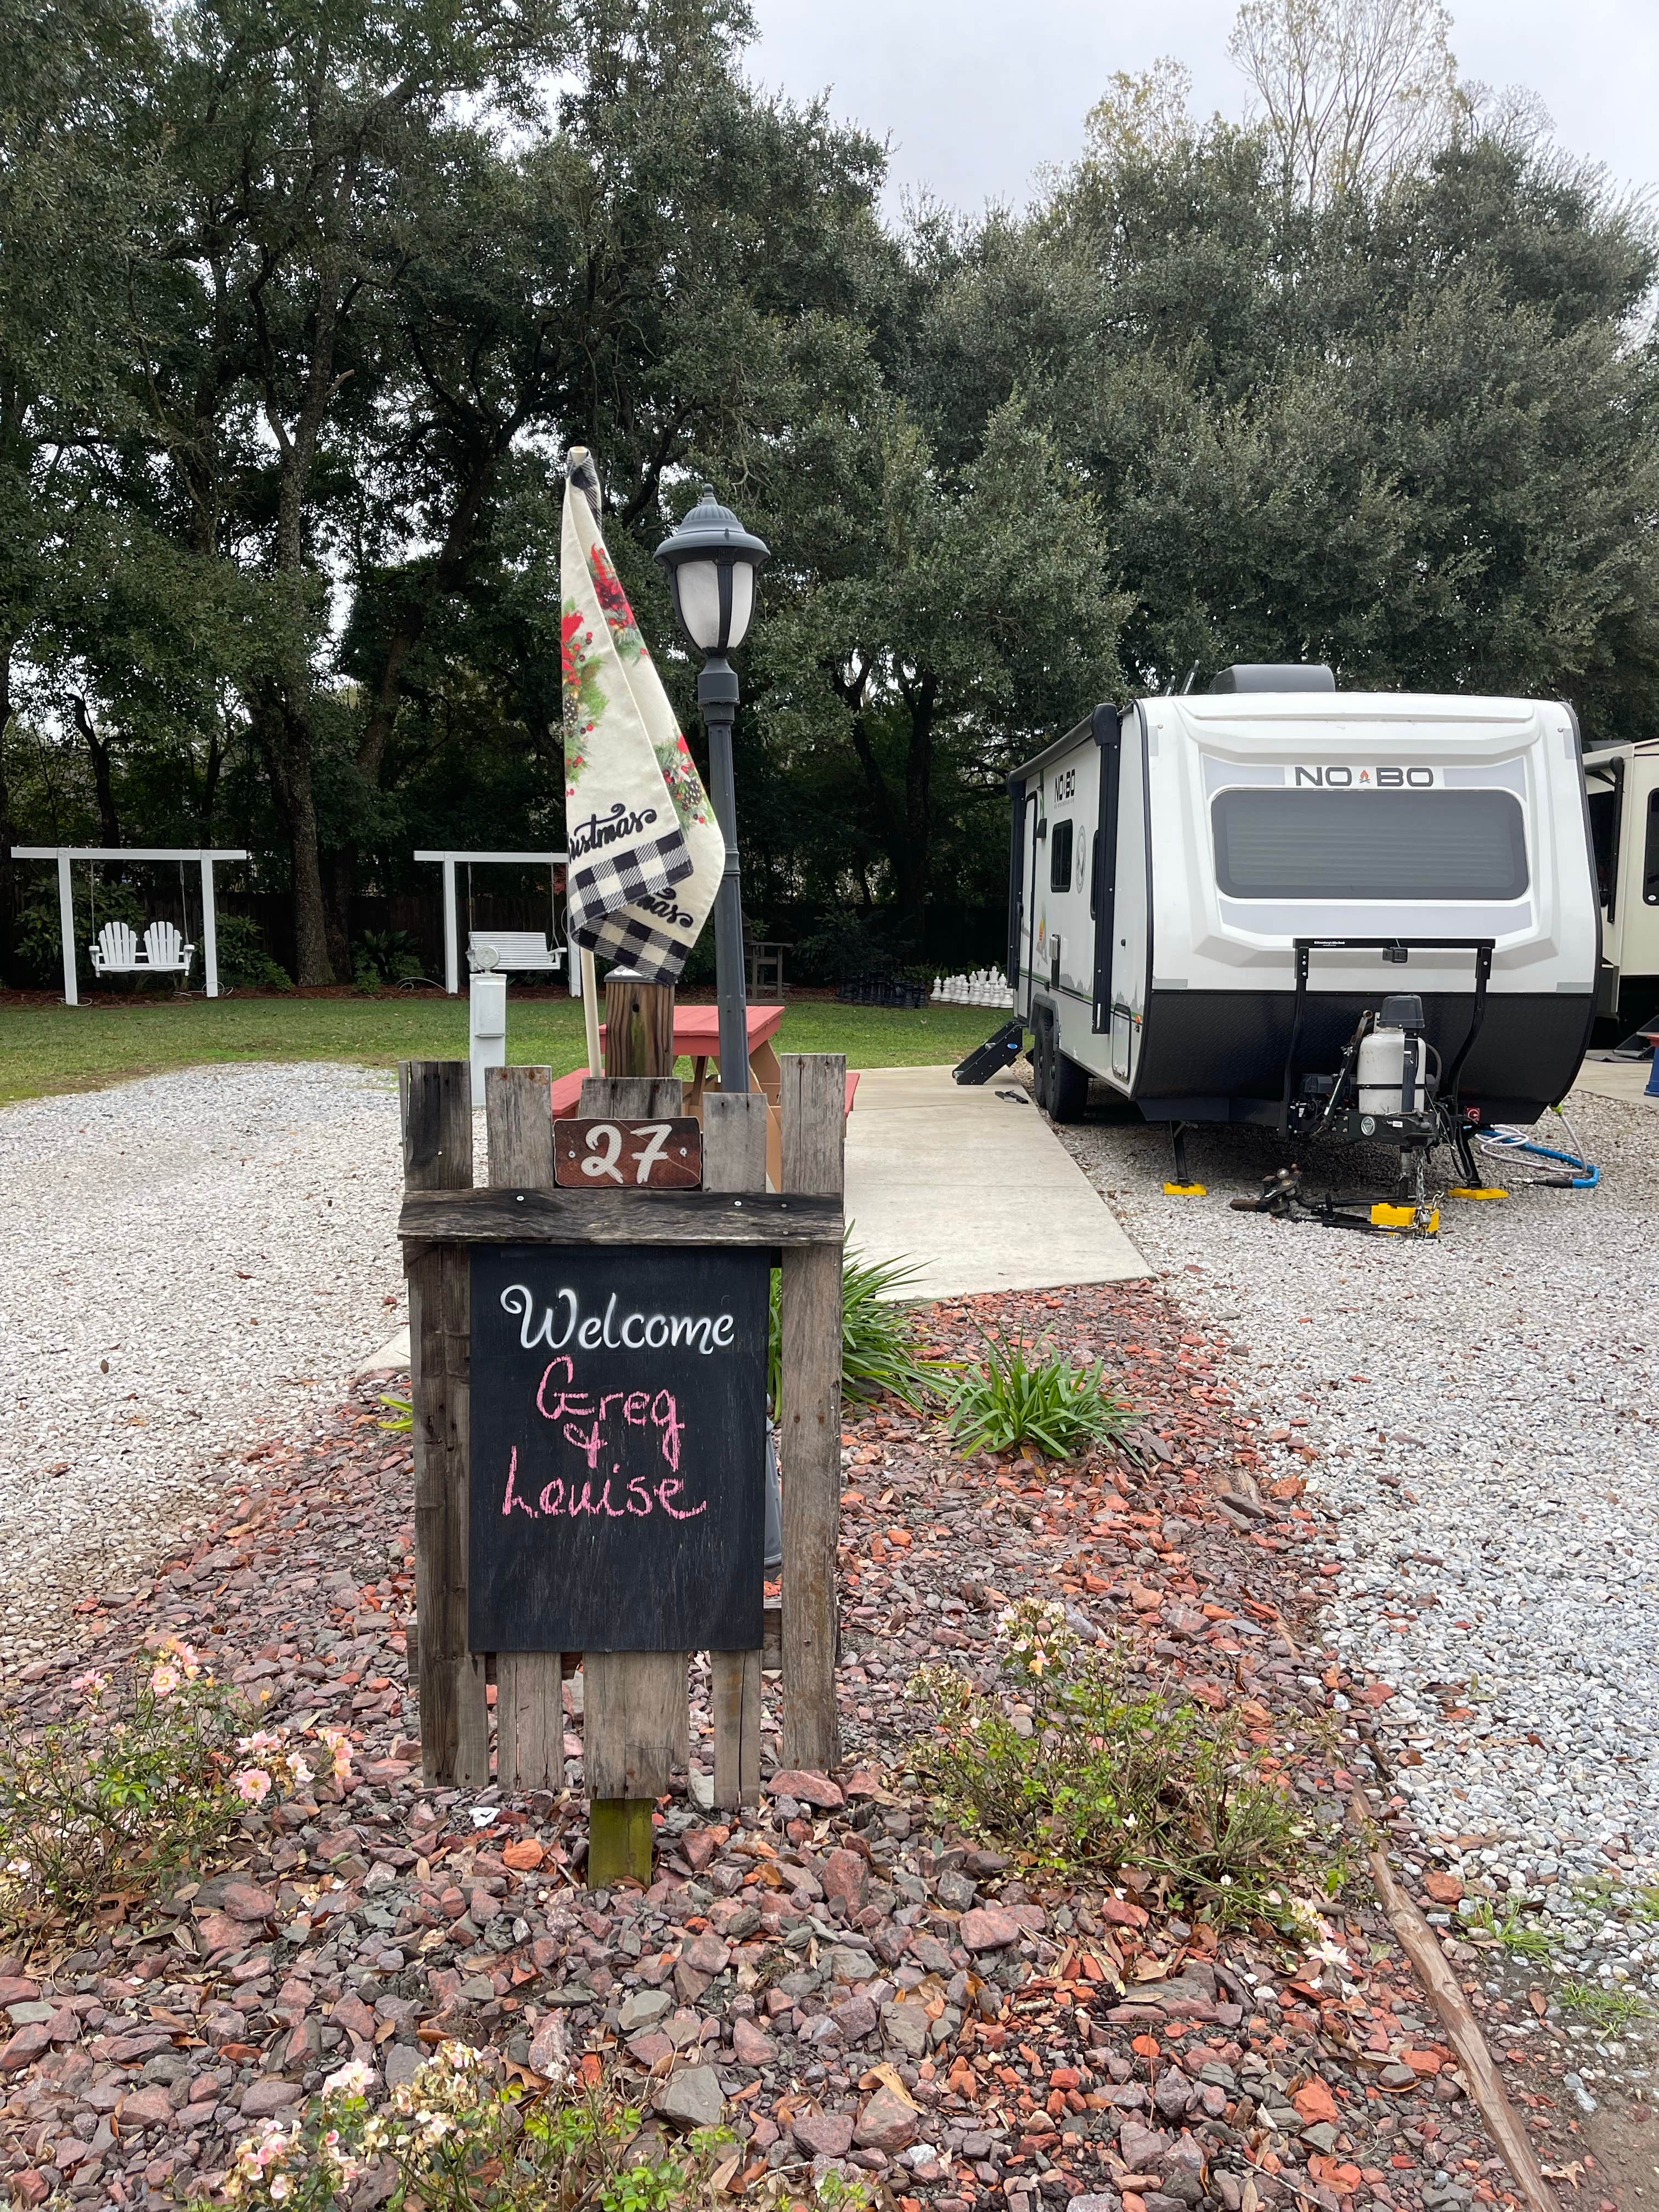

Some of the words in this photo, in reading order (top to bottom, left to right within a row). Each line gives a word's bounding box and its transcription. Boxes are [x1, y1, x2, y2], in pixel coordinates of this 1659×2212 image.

[1295, 767, 1352, 786] NO
[1376, 768, 1434, 787] BO
[580, 1124, 673, 1185] 27
[500, 1284, 735, 1355] Welcome
[535, 1355, 685, 1471] Greg
[501, 1444, 707, 1520] Louise
